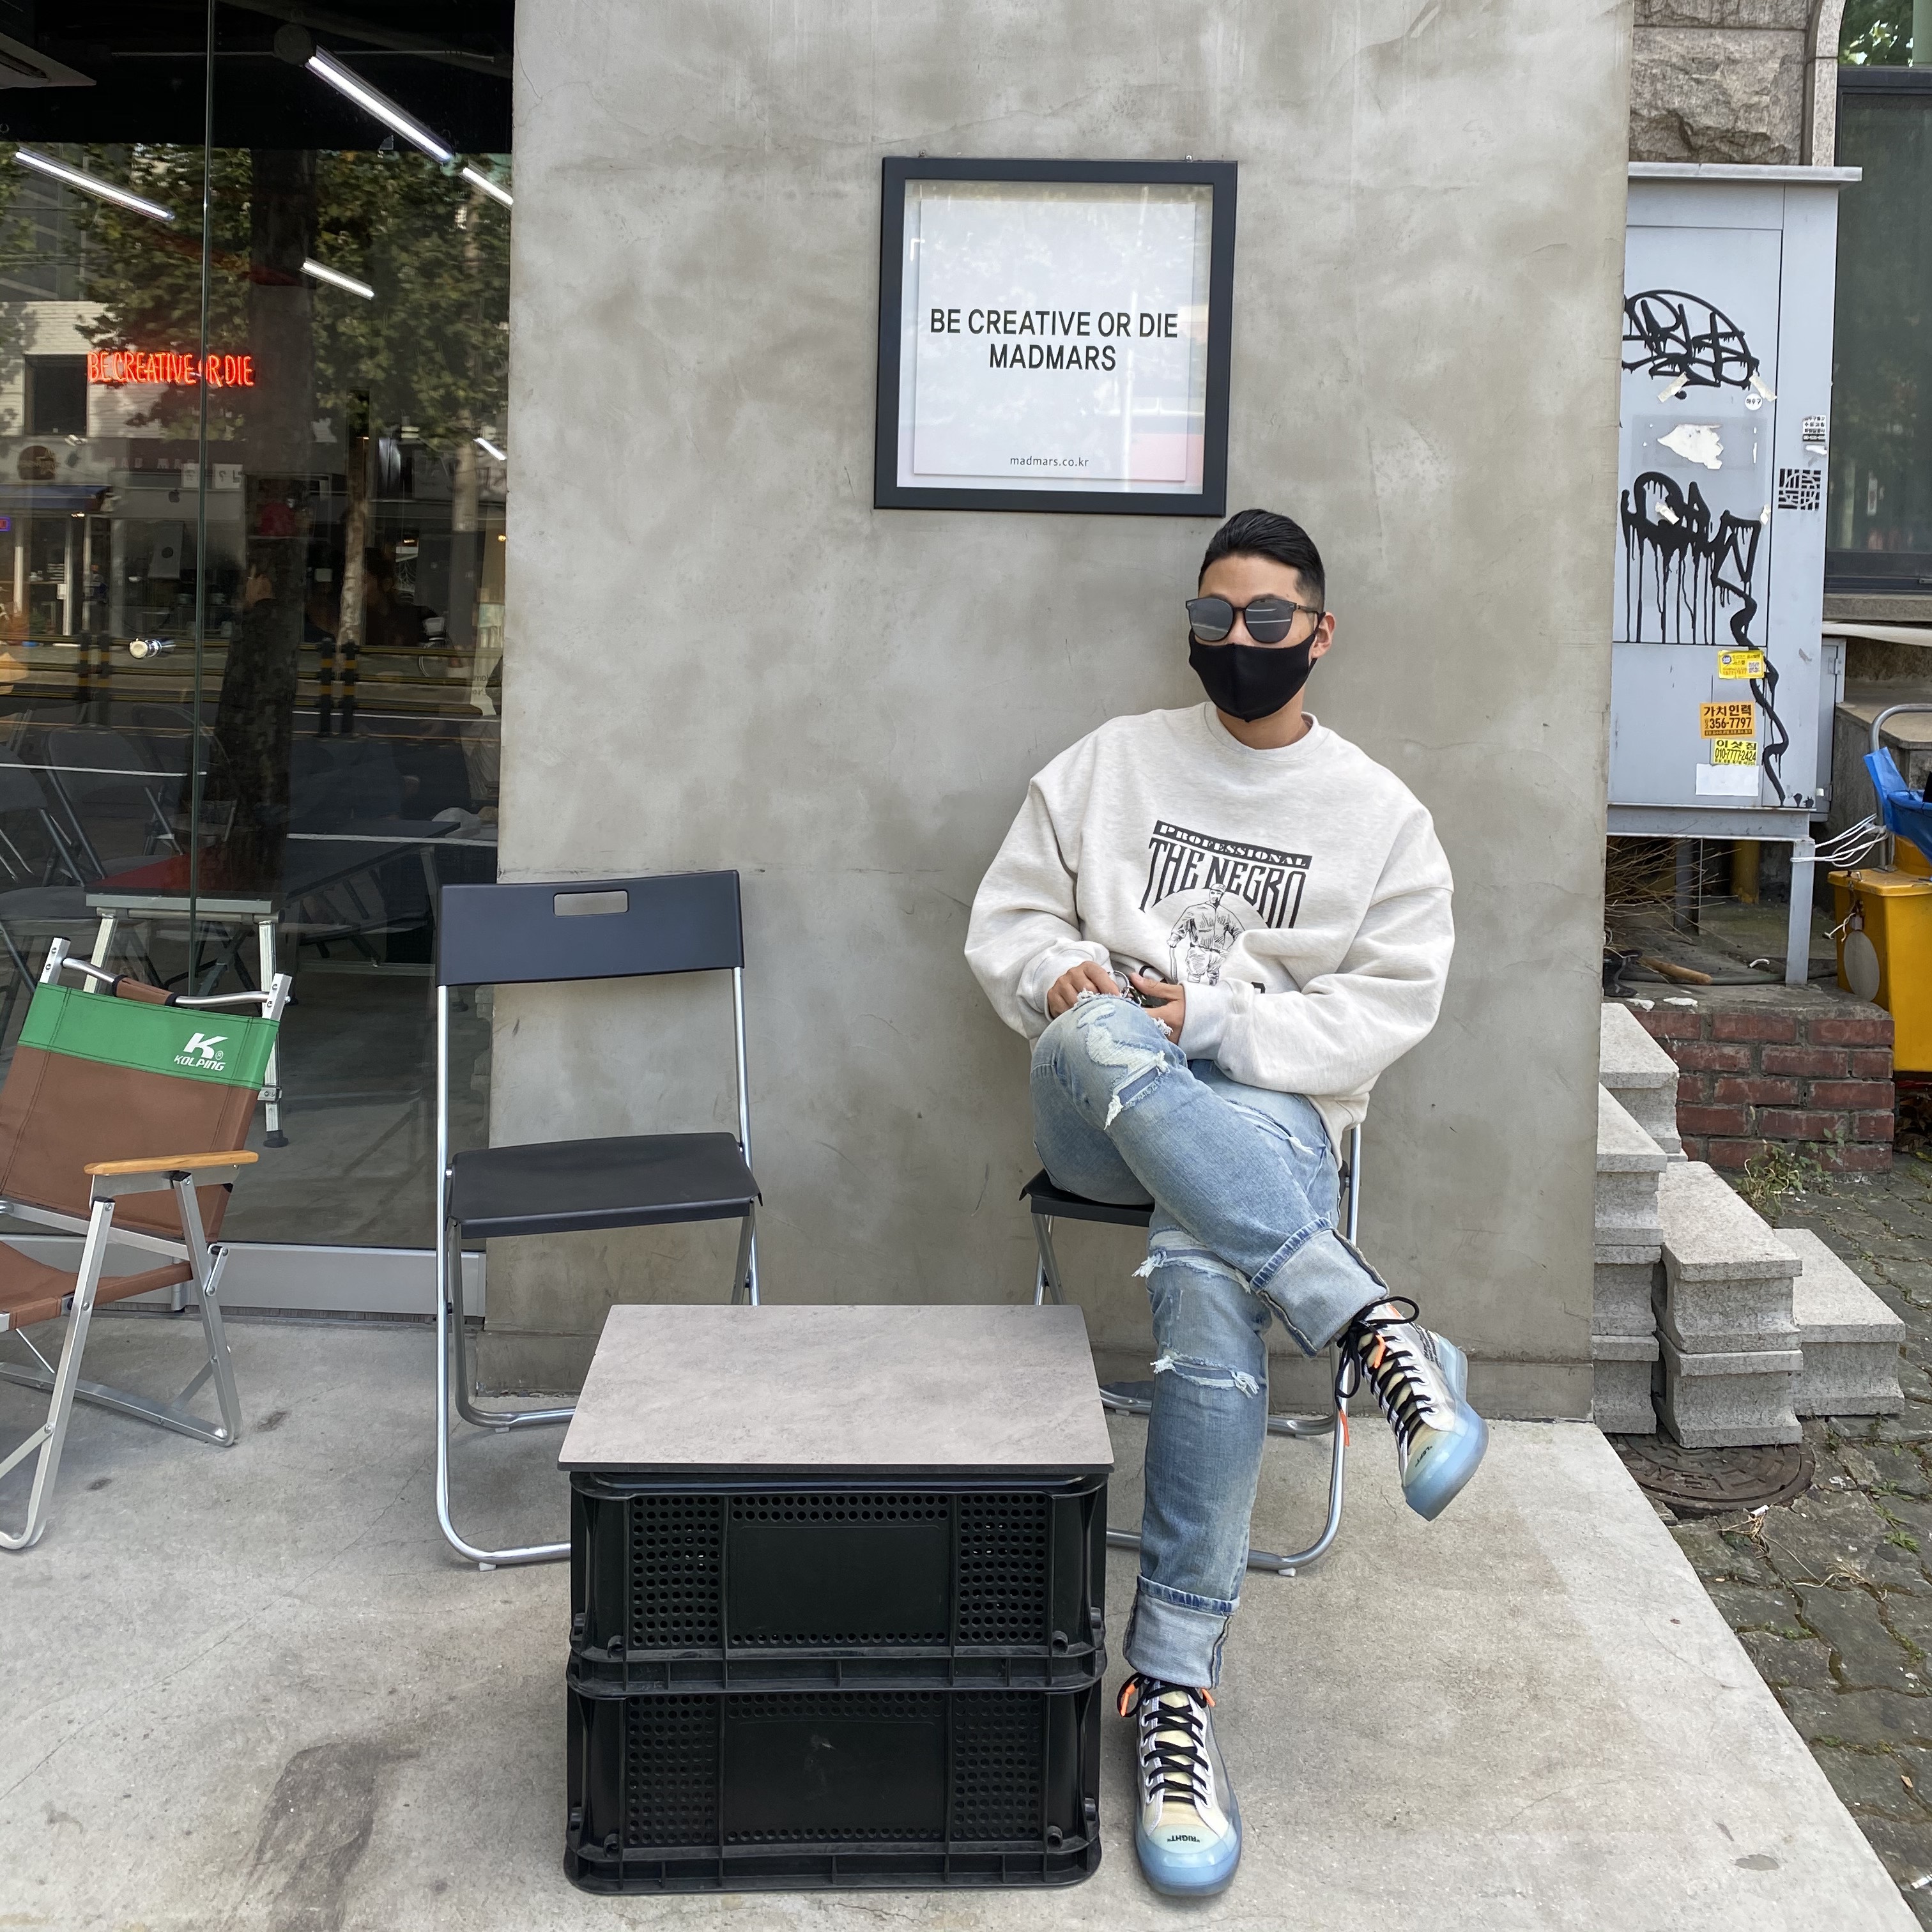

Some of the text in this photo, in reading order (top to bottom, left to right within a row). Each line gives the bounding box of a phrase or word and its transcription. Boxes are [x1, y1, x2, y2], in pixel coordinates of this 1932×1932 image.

[930, 309, 1178, 338] BE CREATIVE OR DIE
[989, 343, 1116, 371] MADMARS
[88, 351, 112, 383] BE
[112, 351, 197, 384] CREATIVE
[224, 355, 255, 388] DIE
[1009, 457, 1089, 467] madmars.co.kr
[1703, 704, 1752, 717] 가치인력
[1709, 717, 1752, 729] 356-7797
[1715, 748, 1756, 762] 010-7777-2424
[1159, 824, 1307, 867] PROFESSIONAL
[1138, 837, 1307, 929] THE NEGRO
[173, 1055, 226, 1071] KOLPING
